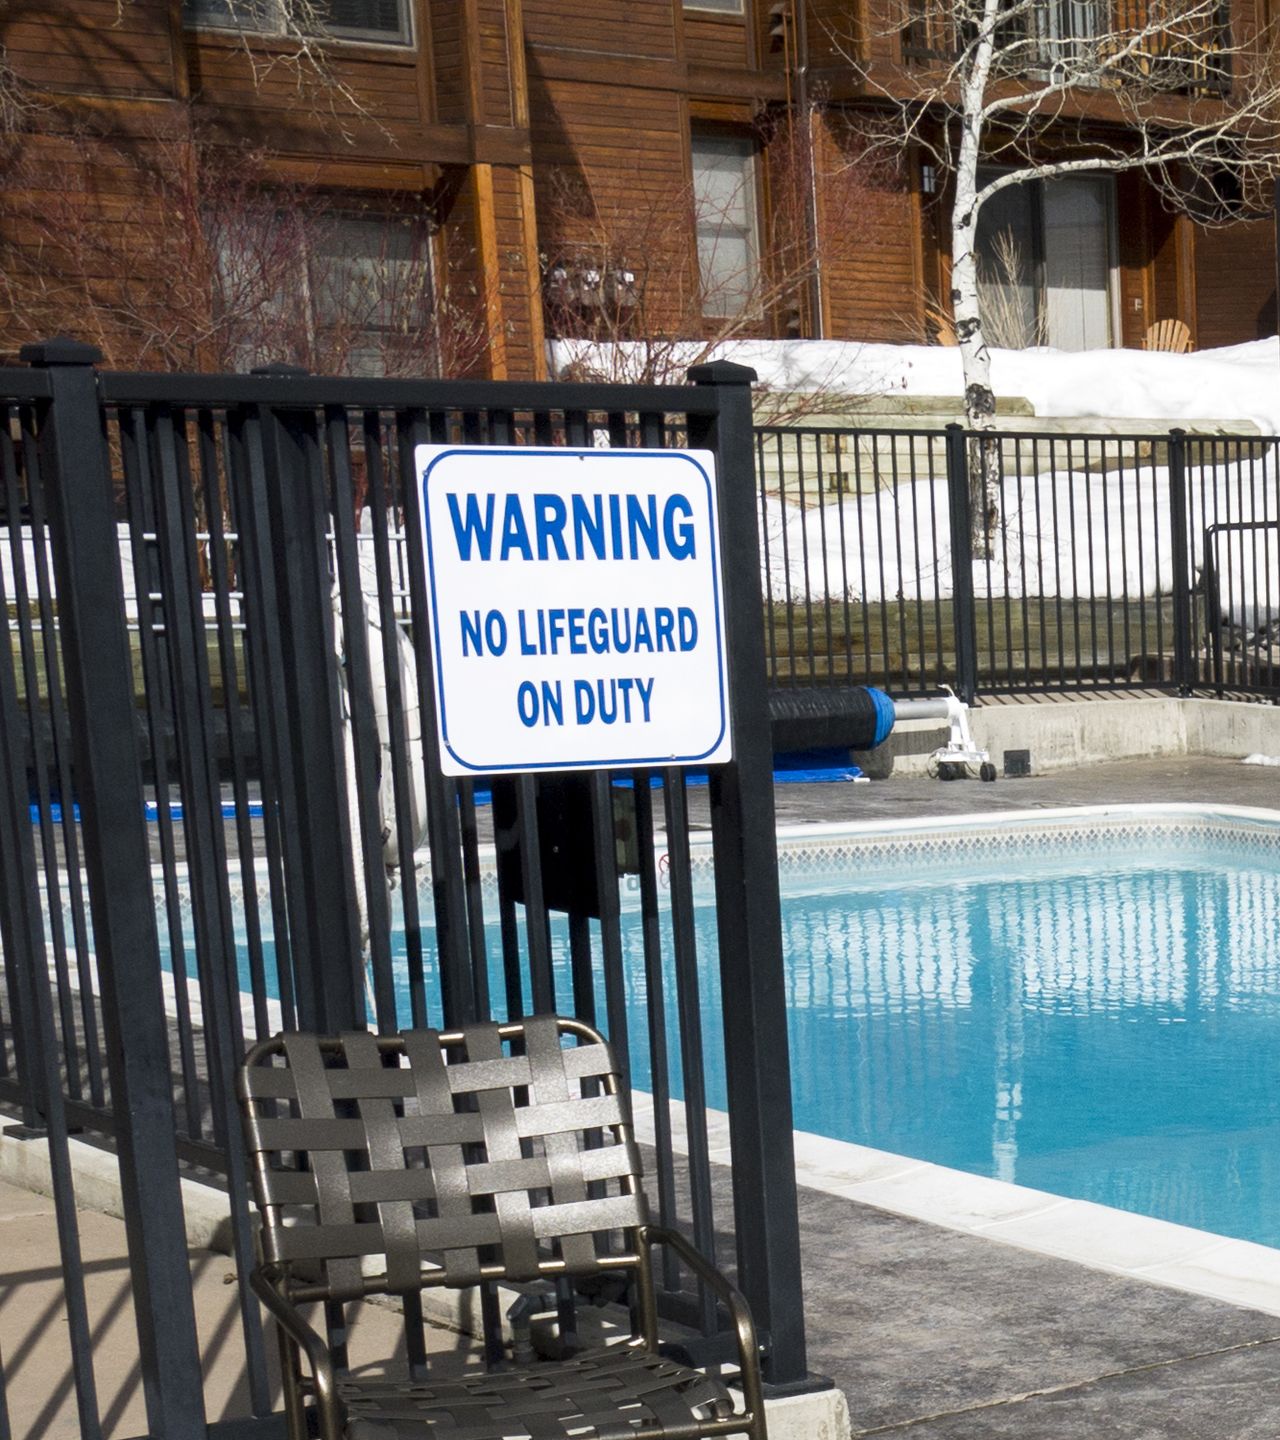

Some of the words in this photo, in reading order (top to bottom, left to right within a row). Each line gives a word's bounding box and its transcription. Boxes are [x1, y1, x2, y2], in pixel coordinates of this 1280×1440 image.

[446, 493, 697, 561] WARNING
[460, 609, 508, 657] NO
[518, 607, 698, 656] LIFEGUARD
[517, 680, 564, 728] ON
[574, 677, 655, 726] DUTY
